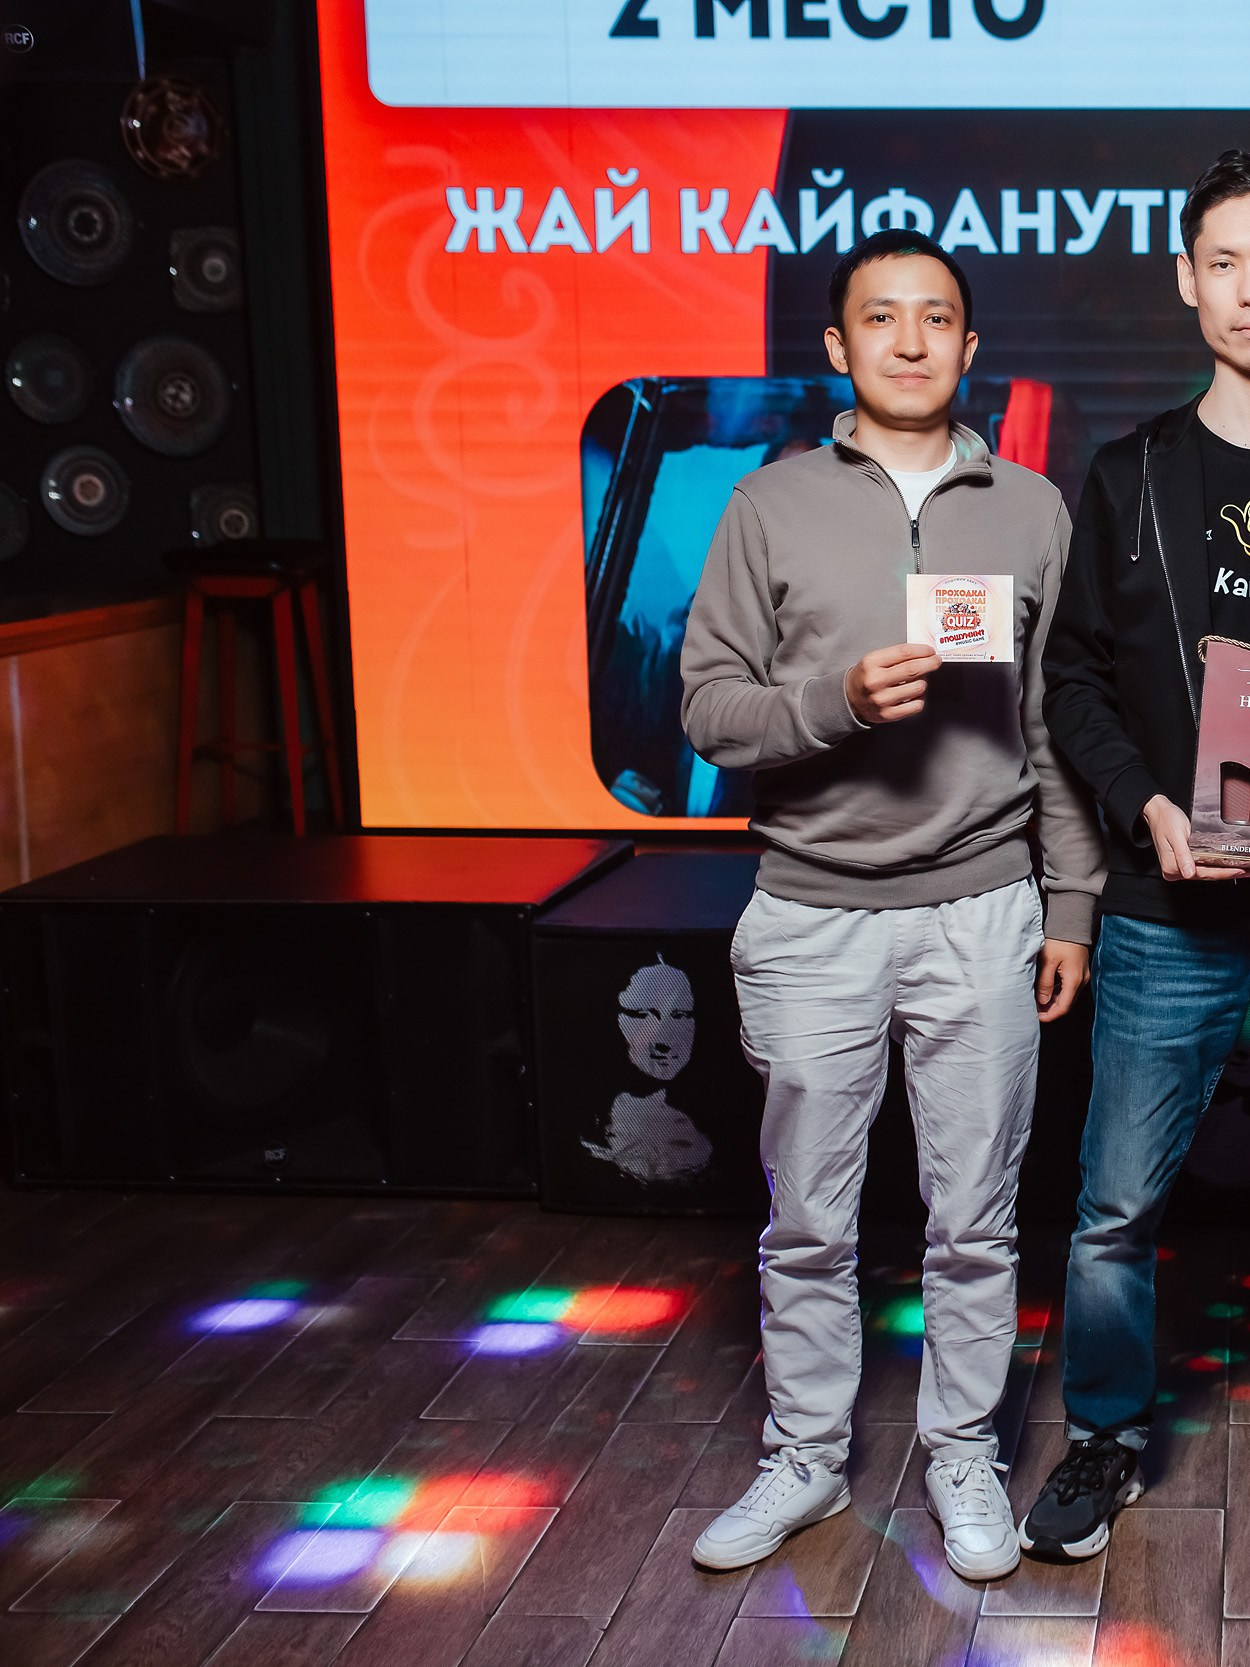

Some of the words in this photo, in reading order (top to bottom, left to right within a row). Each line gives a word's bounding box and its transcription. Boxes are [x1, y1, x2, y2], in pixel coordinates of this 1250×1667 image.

[4, 32, 30, 45] RCF
[445, 168, 650, 254] ЖАЙ
[935, 589, 986, 597] ПРОХОДКА!
[946, 616, 975, 627] QUIZ
